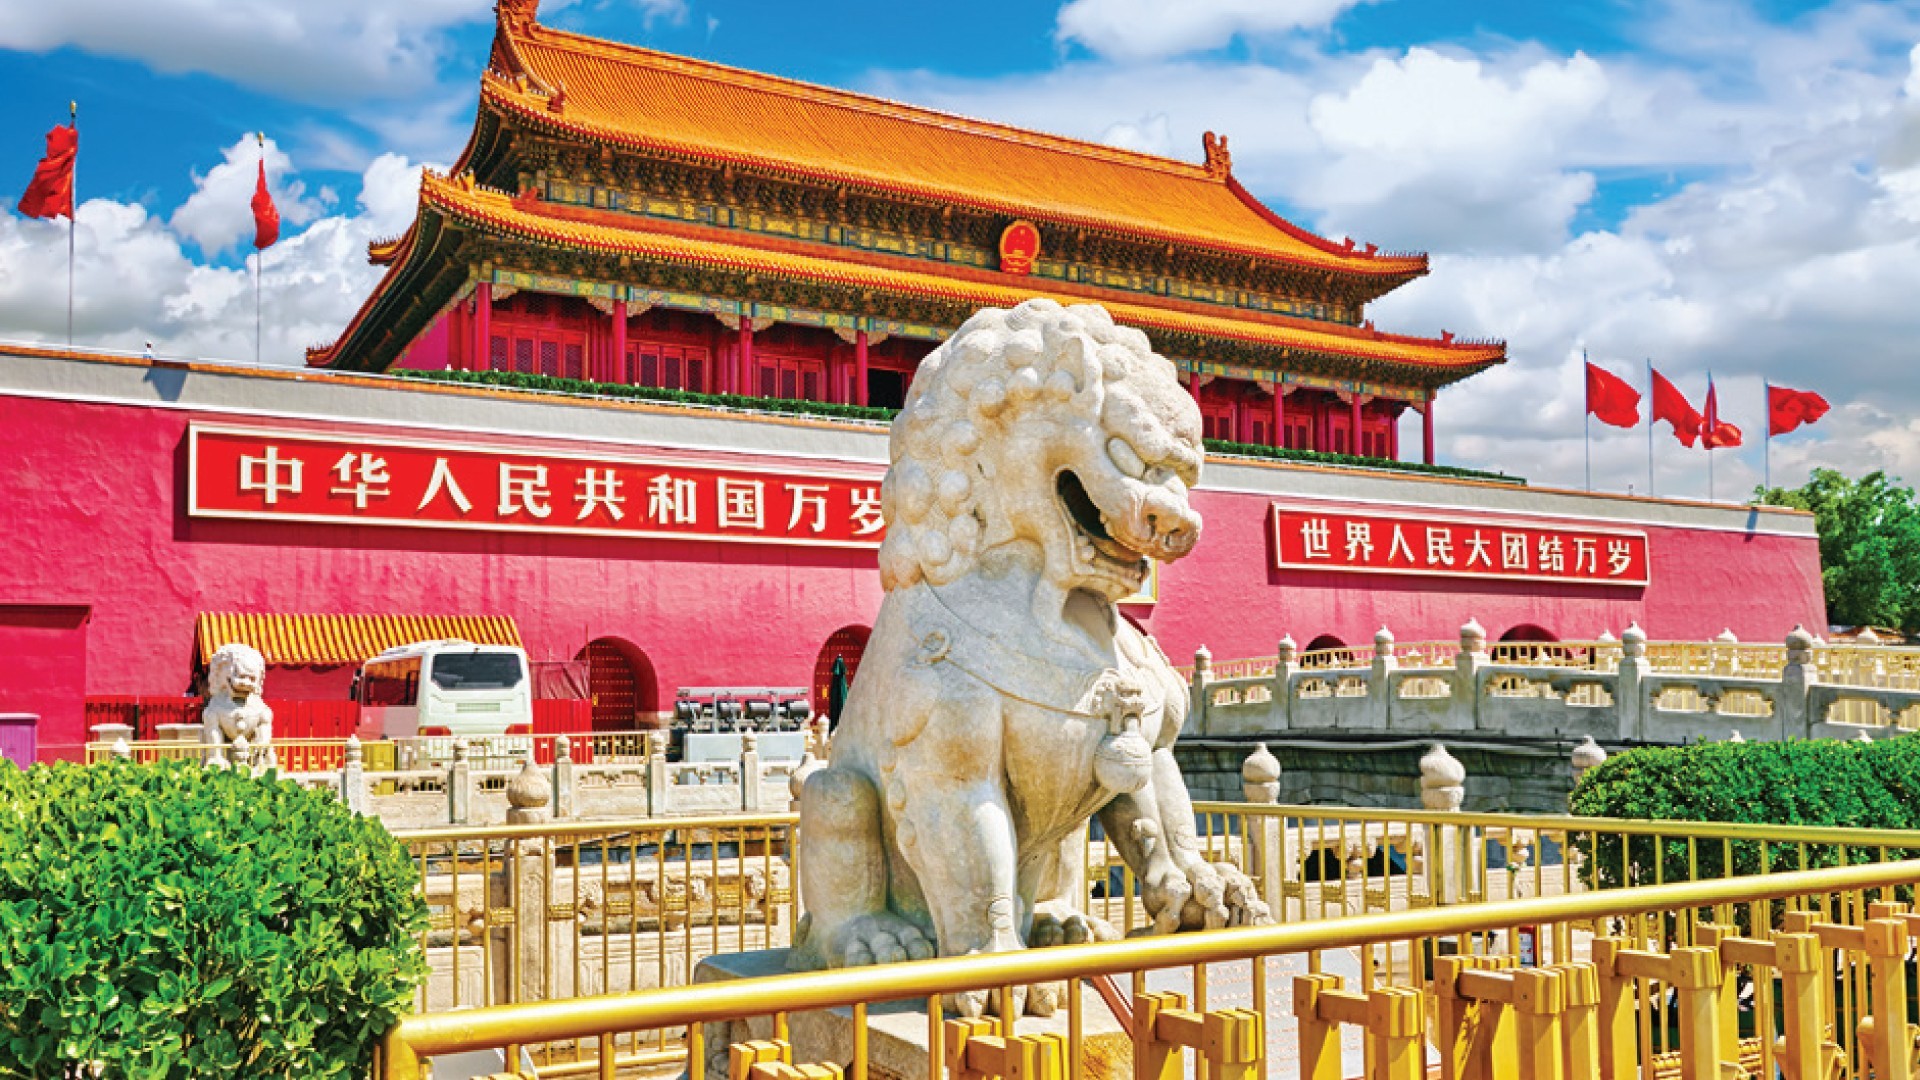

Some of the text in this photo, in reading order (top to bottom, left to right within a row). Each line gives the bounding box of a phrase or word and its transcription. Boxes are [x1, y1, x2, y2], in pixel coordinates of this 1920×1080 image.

[240, 446, 884, 534] 中华人民共和国万岁
[1300, 518, 1631, 576] 世界人民大团结万岁
